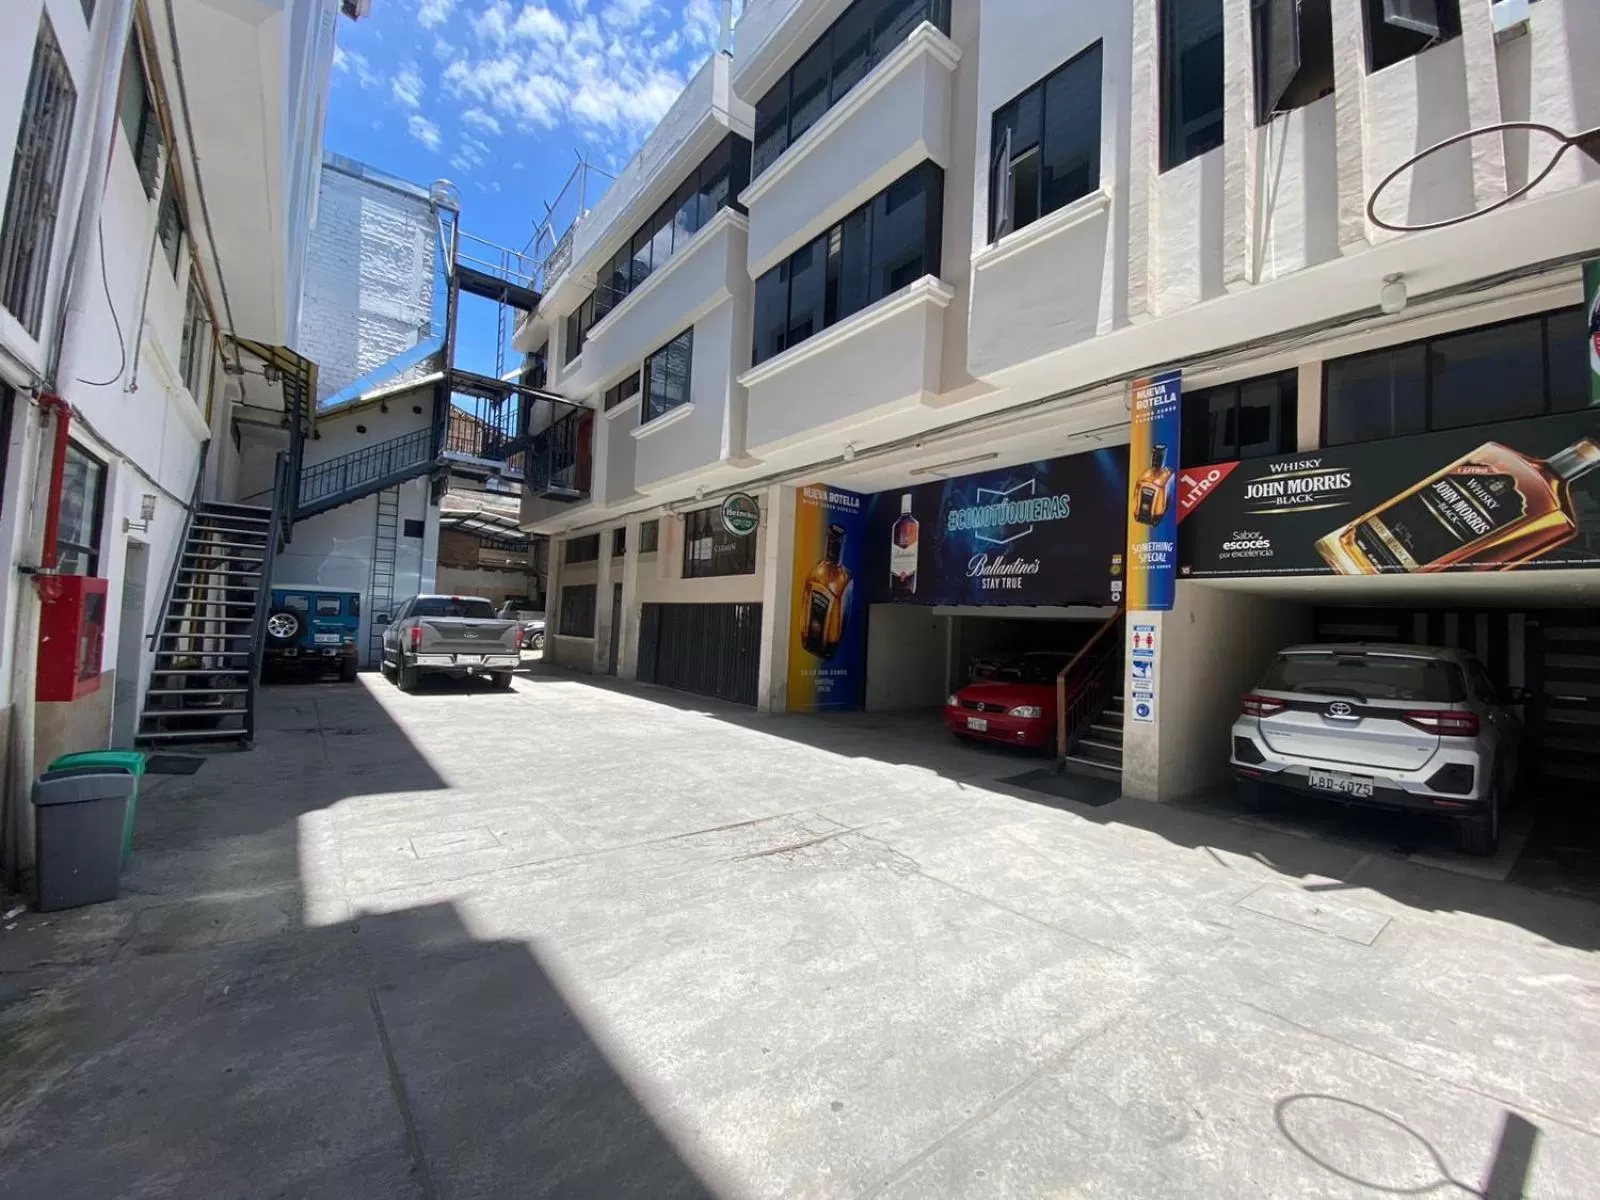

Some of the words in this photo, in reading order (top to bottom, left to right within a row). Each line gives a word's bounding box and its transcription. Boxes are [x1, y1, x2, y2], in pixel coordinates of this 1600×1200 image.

[1136, 392, 1177, 410] BOTELLA
[1269, 458, 1322, 474] WHISKY
[1180, 473, 1199, 488] 1
[1181, 468, 1222, 509] LITRO
[1244, 479, 1285, 500] JOHN
[1287, 472, 1352, 490] MORRIS
[829, 491, 861, 508] BOTELLA
[1275, 493, 1314, 506] BLACK
[1466, 478, 1498, 509] WHISKY
[1431, 480, 1461, 504] JOHN
[1451, 499, 1491, 535] MORRIS
[1437, 501, 1461, 524] BLACK
[1222, 536, 1271, 551] escocés
[1232, 530, 1260, 541] Sabor
[1131, 541, 1174, 555] SOMETHING
[1218, 551, 1231, 560] por
[1232, 549, 1274, 559] excelencia
[965, 552, 1040, 577] Ballantine's
[1138, 552, 1167, 564] SPECIAL
[982, 577, 1000, 590] STAY
[1002, 576, 1022, 589] TRUE
